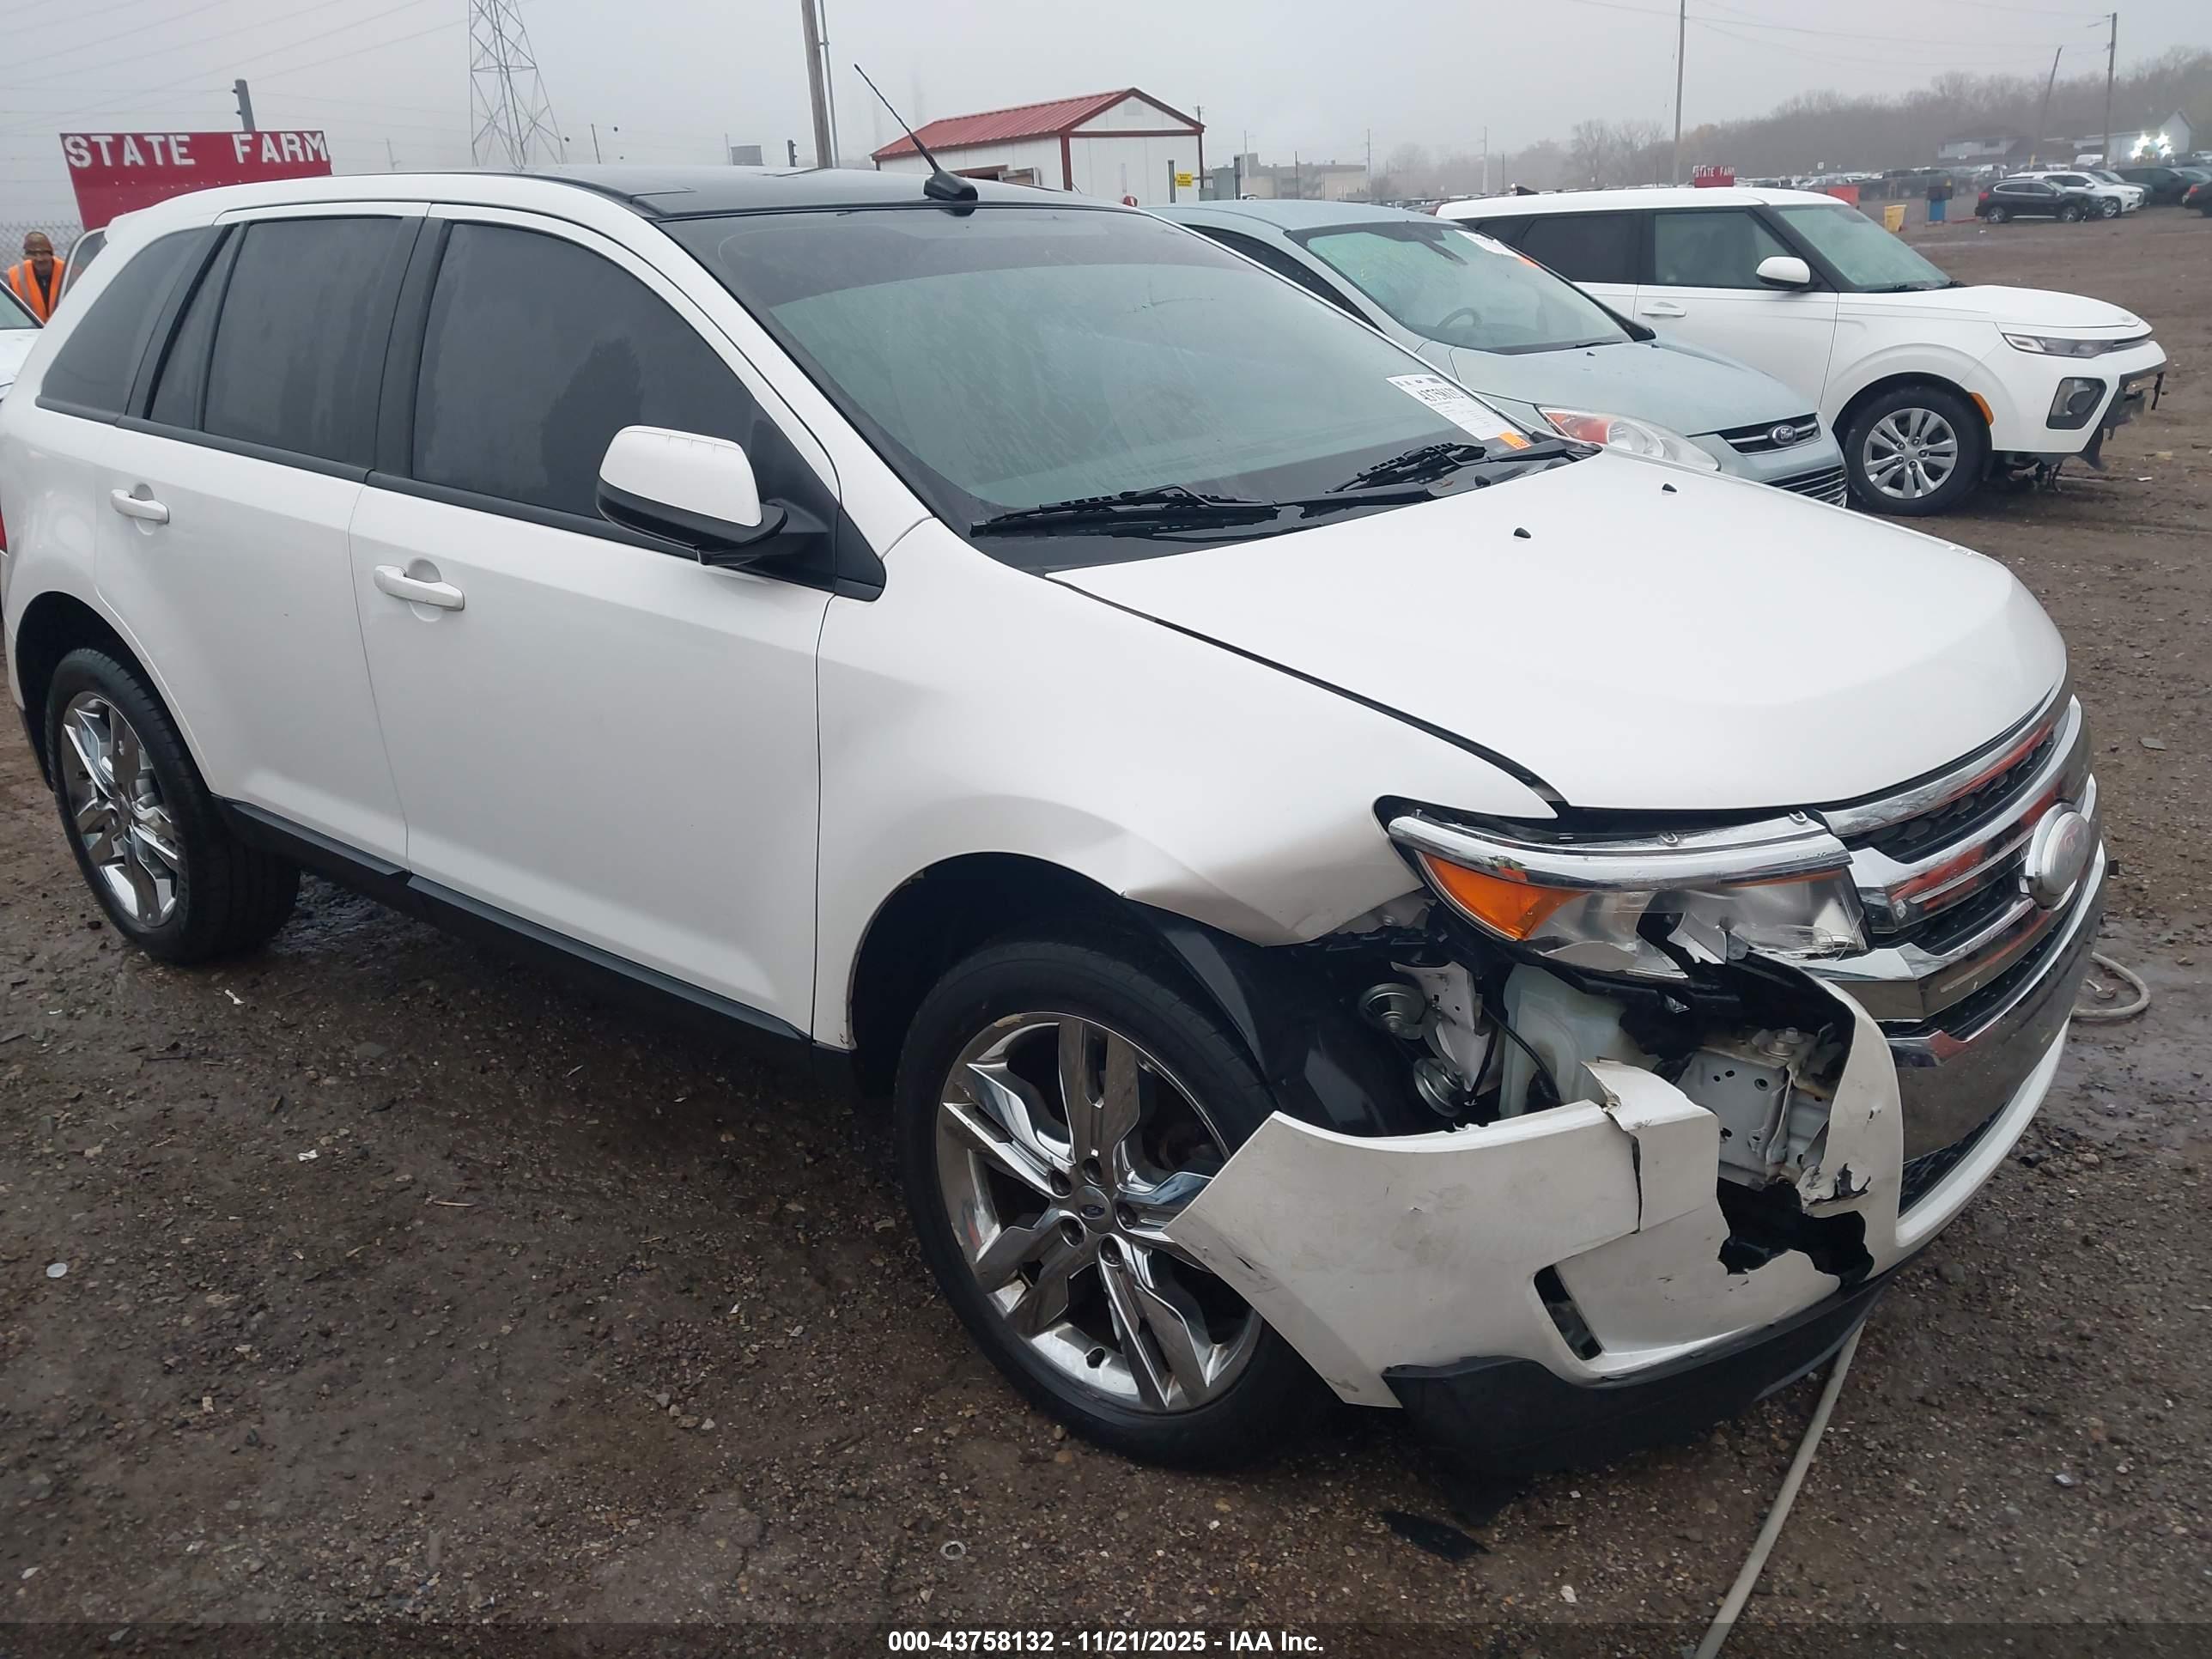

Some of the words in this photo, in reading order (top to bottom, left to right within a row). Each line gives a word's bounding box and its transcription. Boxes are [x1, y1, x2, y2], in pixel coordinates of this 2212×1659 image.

[64, 134, 196, 167] STATE
[232, 132, 329, 163] FARM
[1694, 166, 1715, 178] STATE
